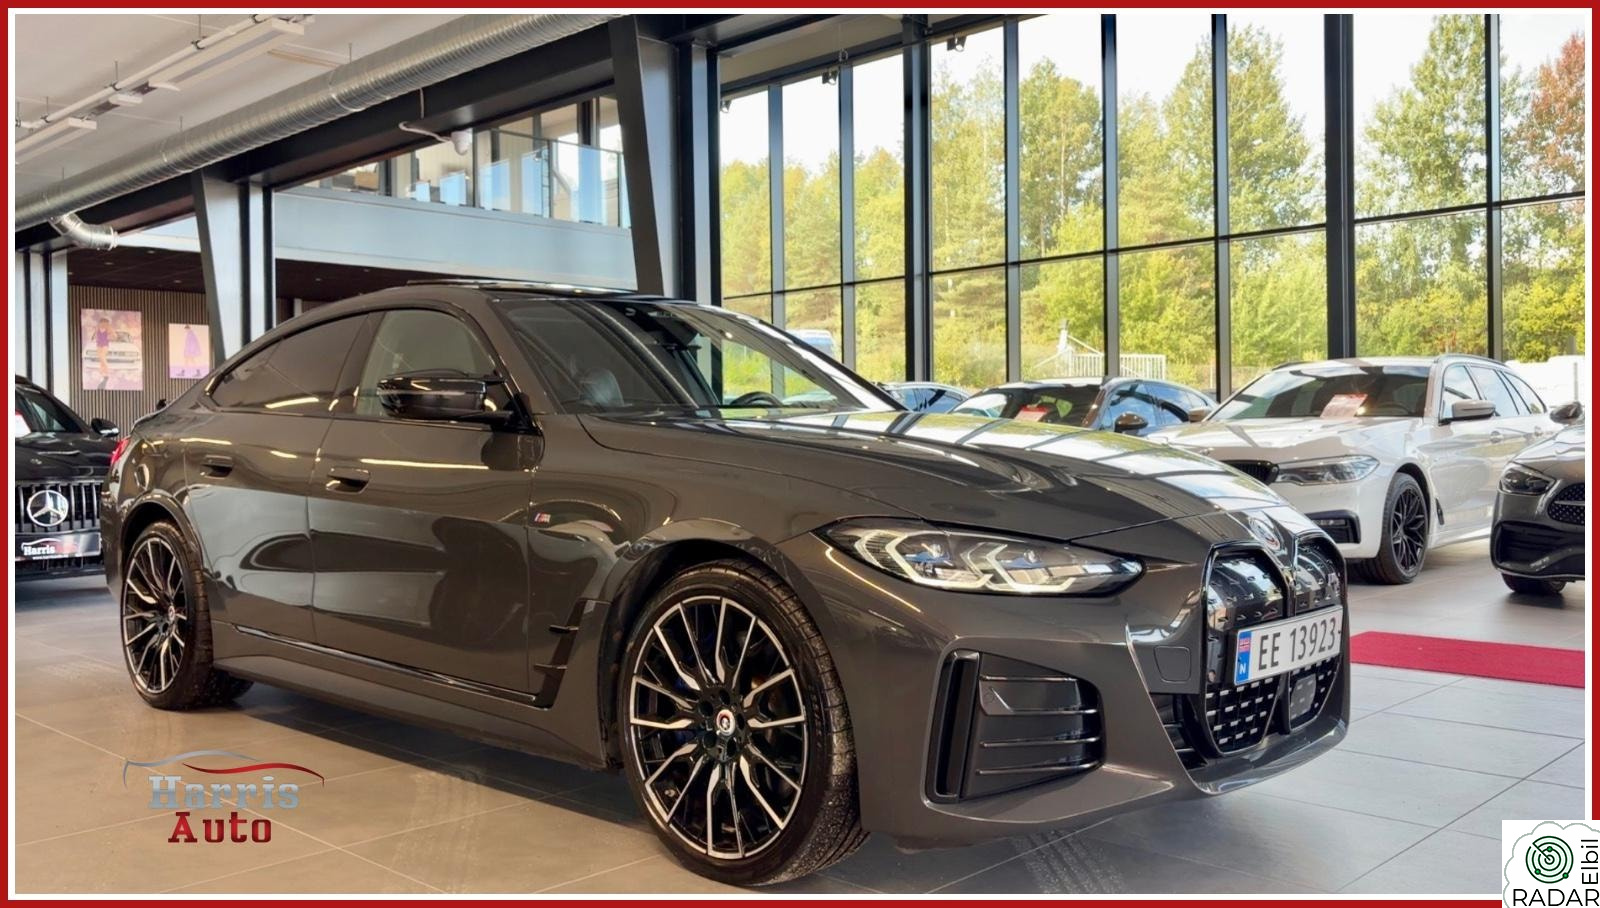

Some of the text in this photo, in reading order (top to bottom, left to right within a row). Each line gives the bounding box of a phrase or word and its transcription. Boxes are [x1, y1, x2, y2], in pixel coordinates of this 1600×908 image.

[23, 545, 56, 556] Harris
[1258, 617, 1337, 671] EE 13923
[1238, 662, 1247, 675] N
